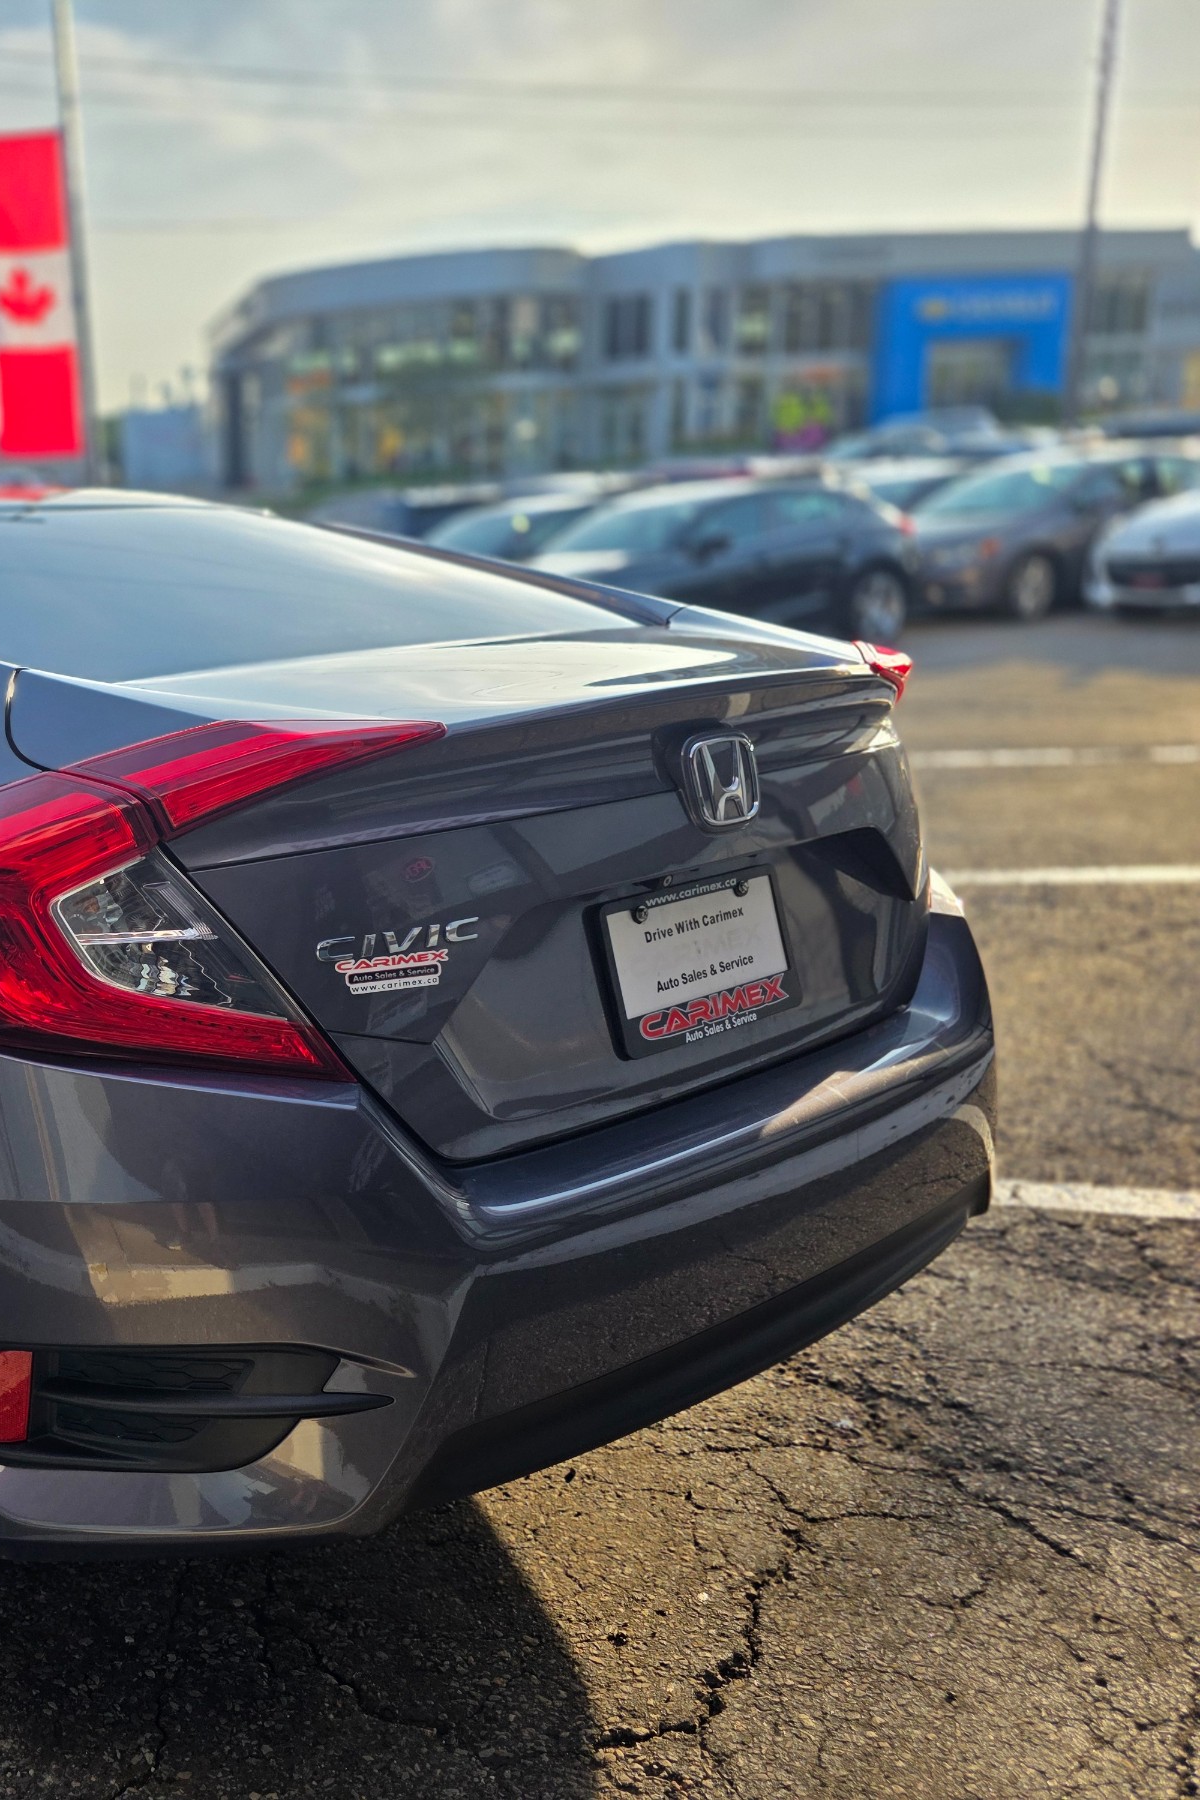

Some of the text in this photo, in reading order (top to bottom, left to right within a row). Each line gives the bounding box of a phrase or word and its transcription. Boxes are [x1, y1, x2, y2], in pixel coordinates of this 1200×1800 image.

[645, 878, 737, 907] www.carimex.ca
[316, 917, 479, 962] CIVIC
[644, 907, 744, 943] Drive With Carimex
[336, 951, 447, 971] CARIMEX
[352, 974, 373, 983] Auto
[375, 970, 397, 980] Sales
[407, 967, 435, 976] Service
[657, 954, 754, 993] Auto Sales & Service
[639, 973, 789, 1040] CARIMEX
[685, 1011, 758, 1043] Auto Sales & Service
